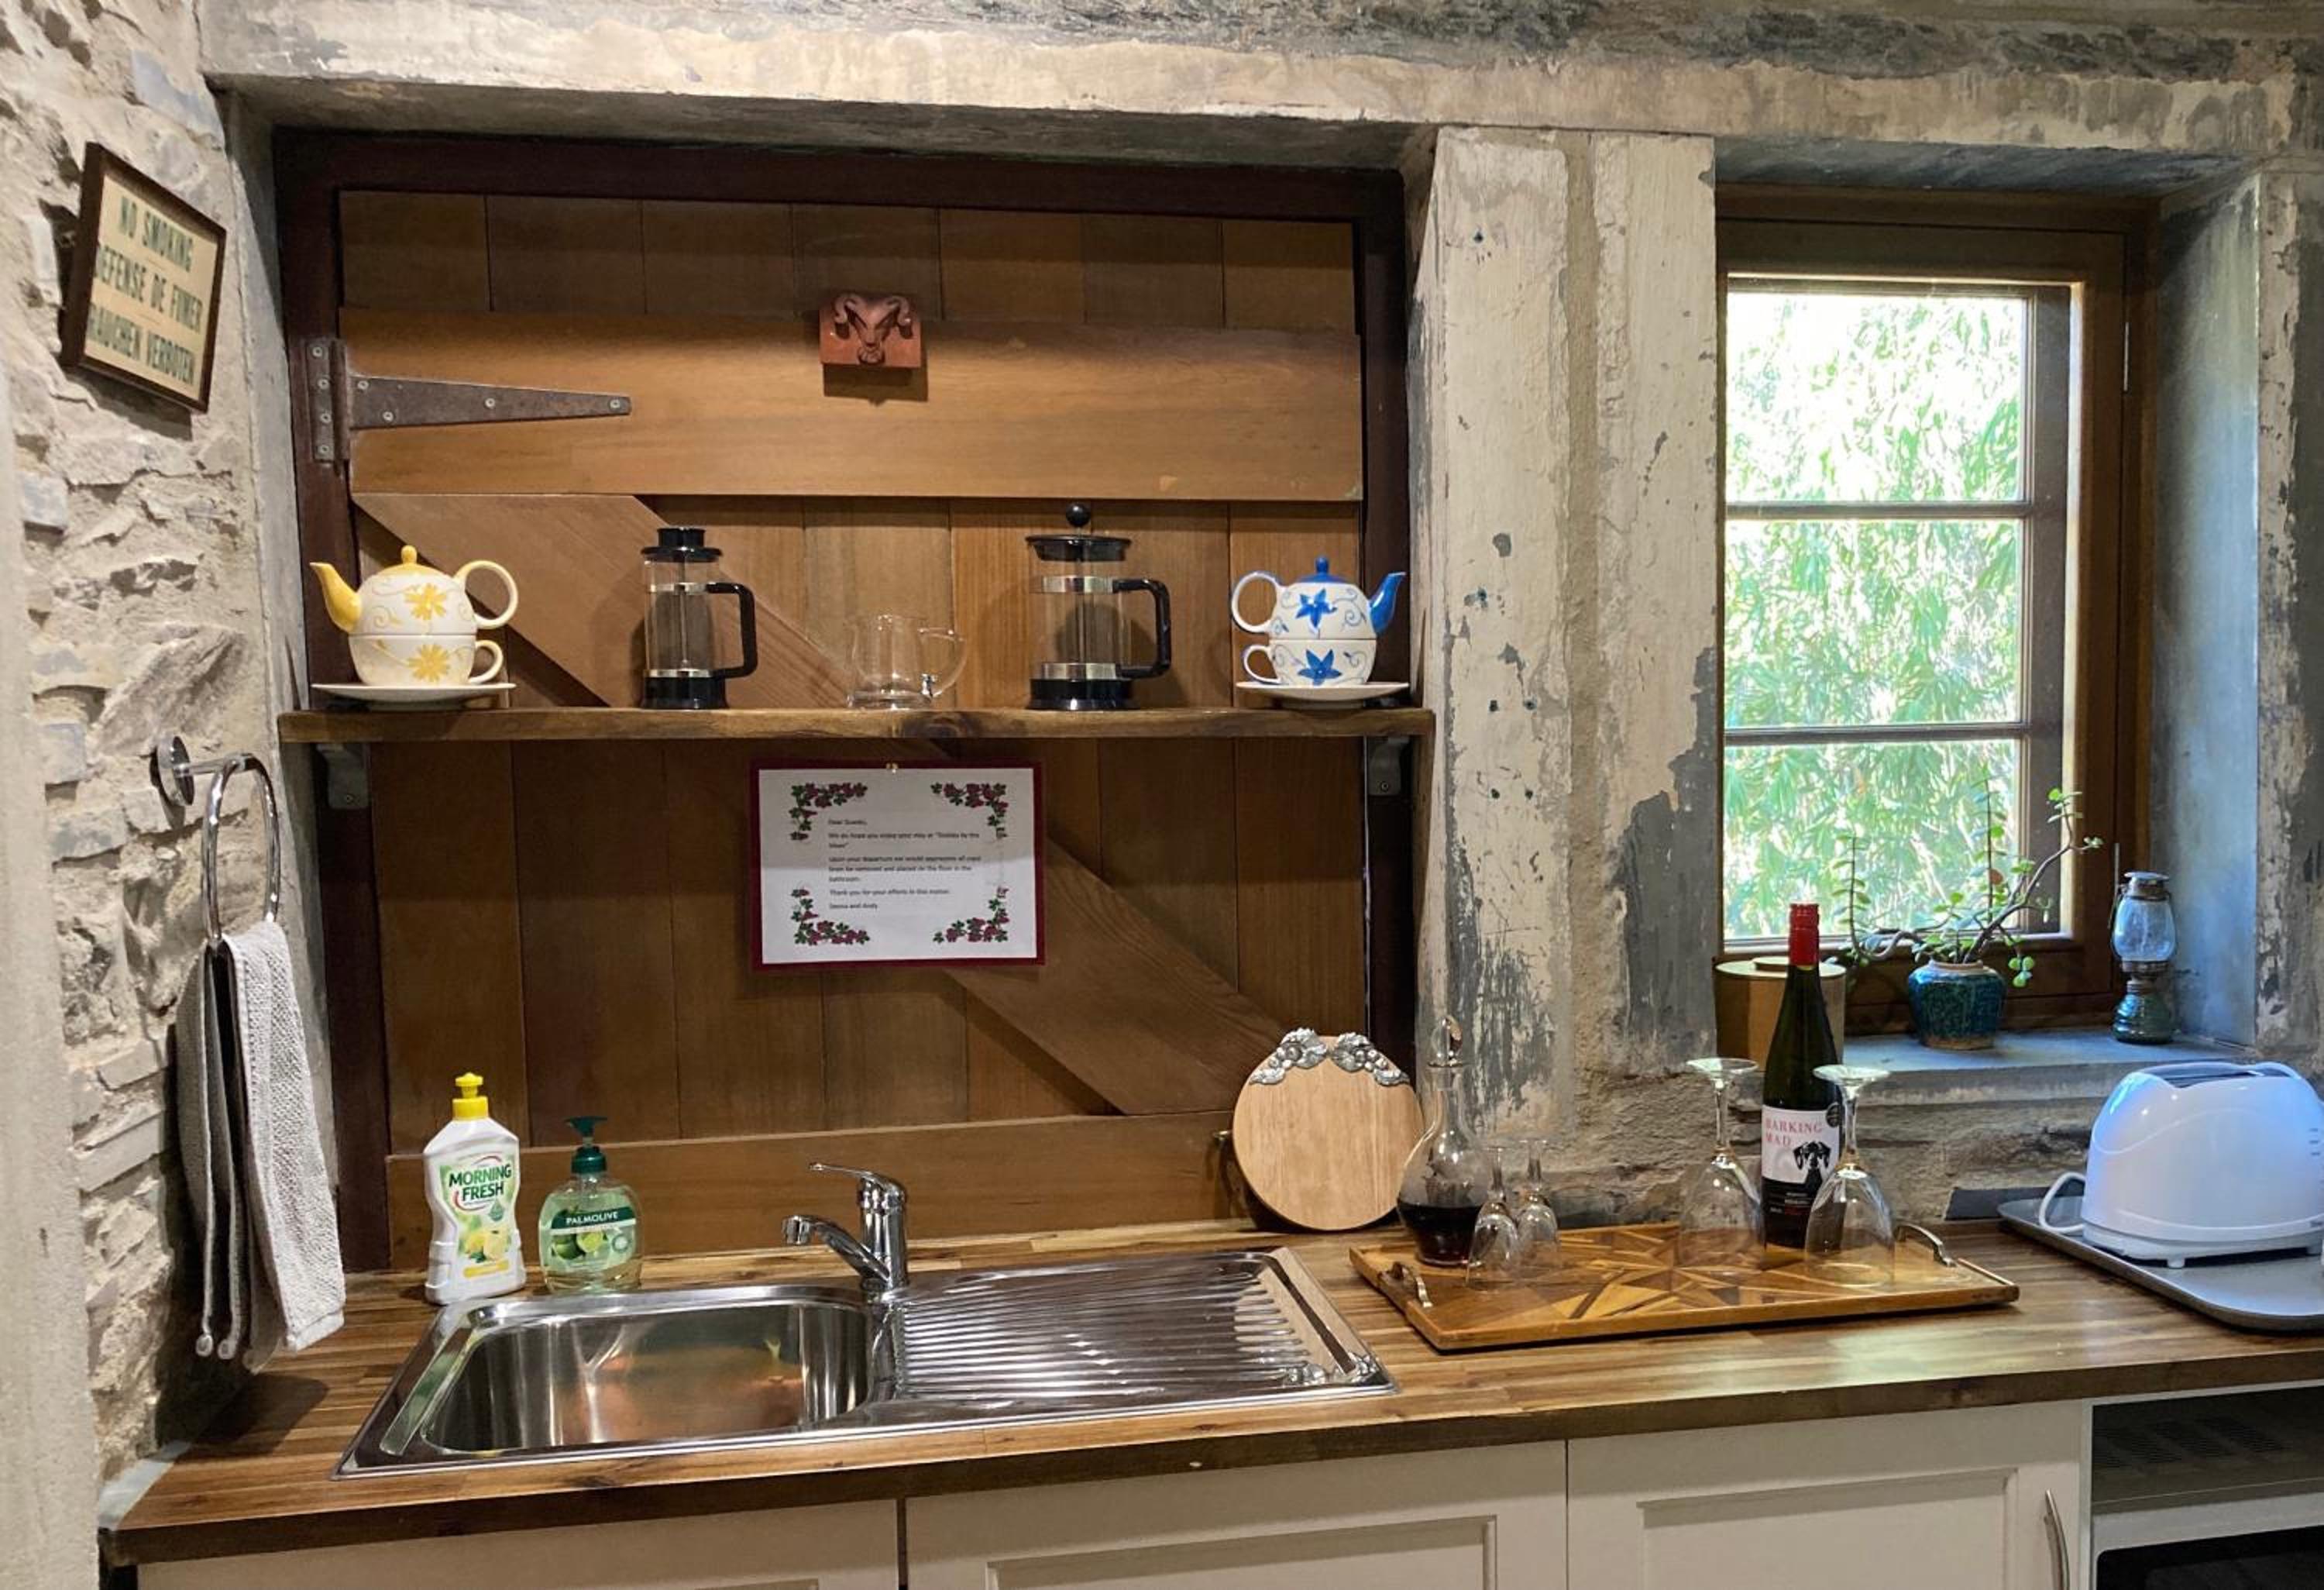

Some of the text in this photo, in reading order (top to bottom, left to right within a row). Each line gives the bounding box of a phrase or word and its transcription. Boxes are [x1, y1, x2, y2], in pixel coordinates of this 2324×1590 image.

[142, 210, 193, 272] SMOKING
[449, 1163, 512, 1188] MORNING
[462, 1182, 504, 1201] FRESH
[566, 1211, 619, 1225] PALMOLIVE
